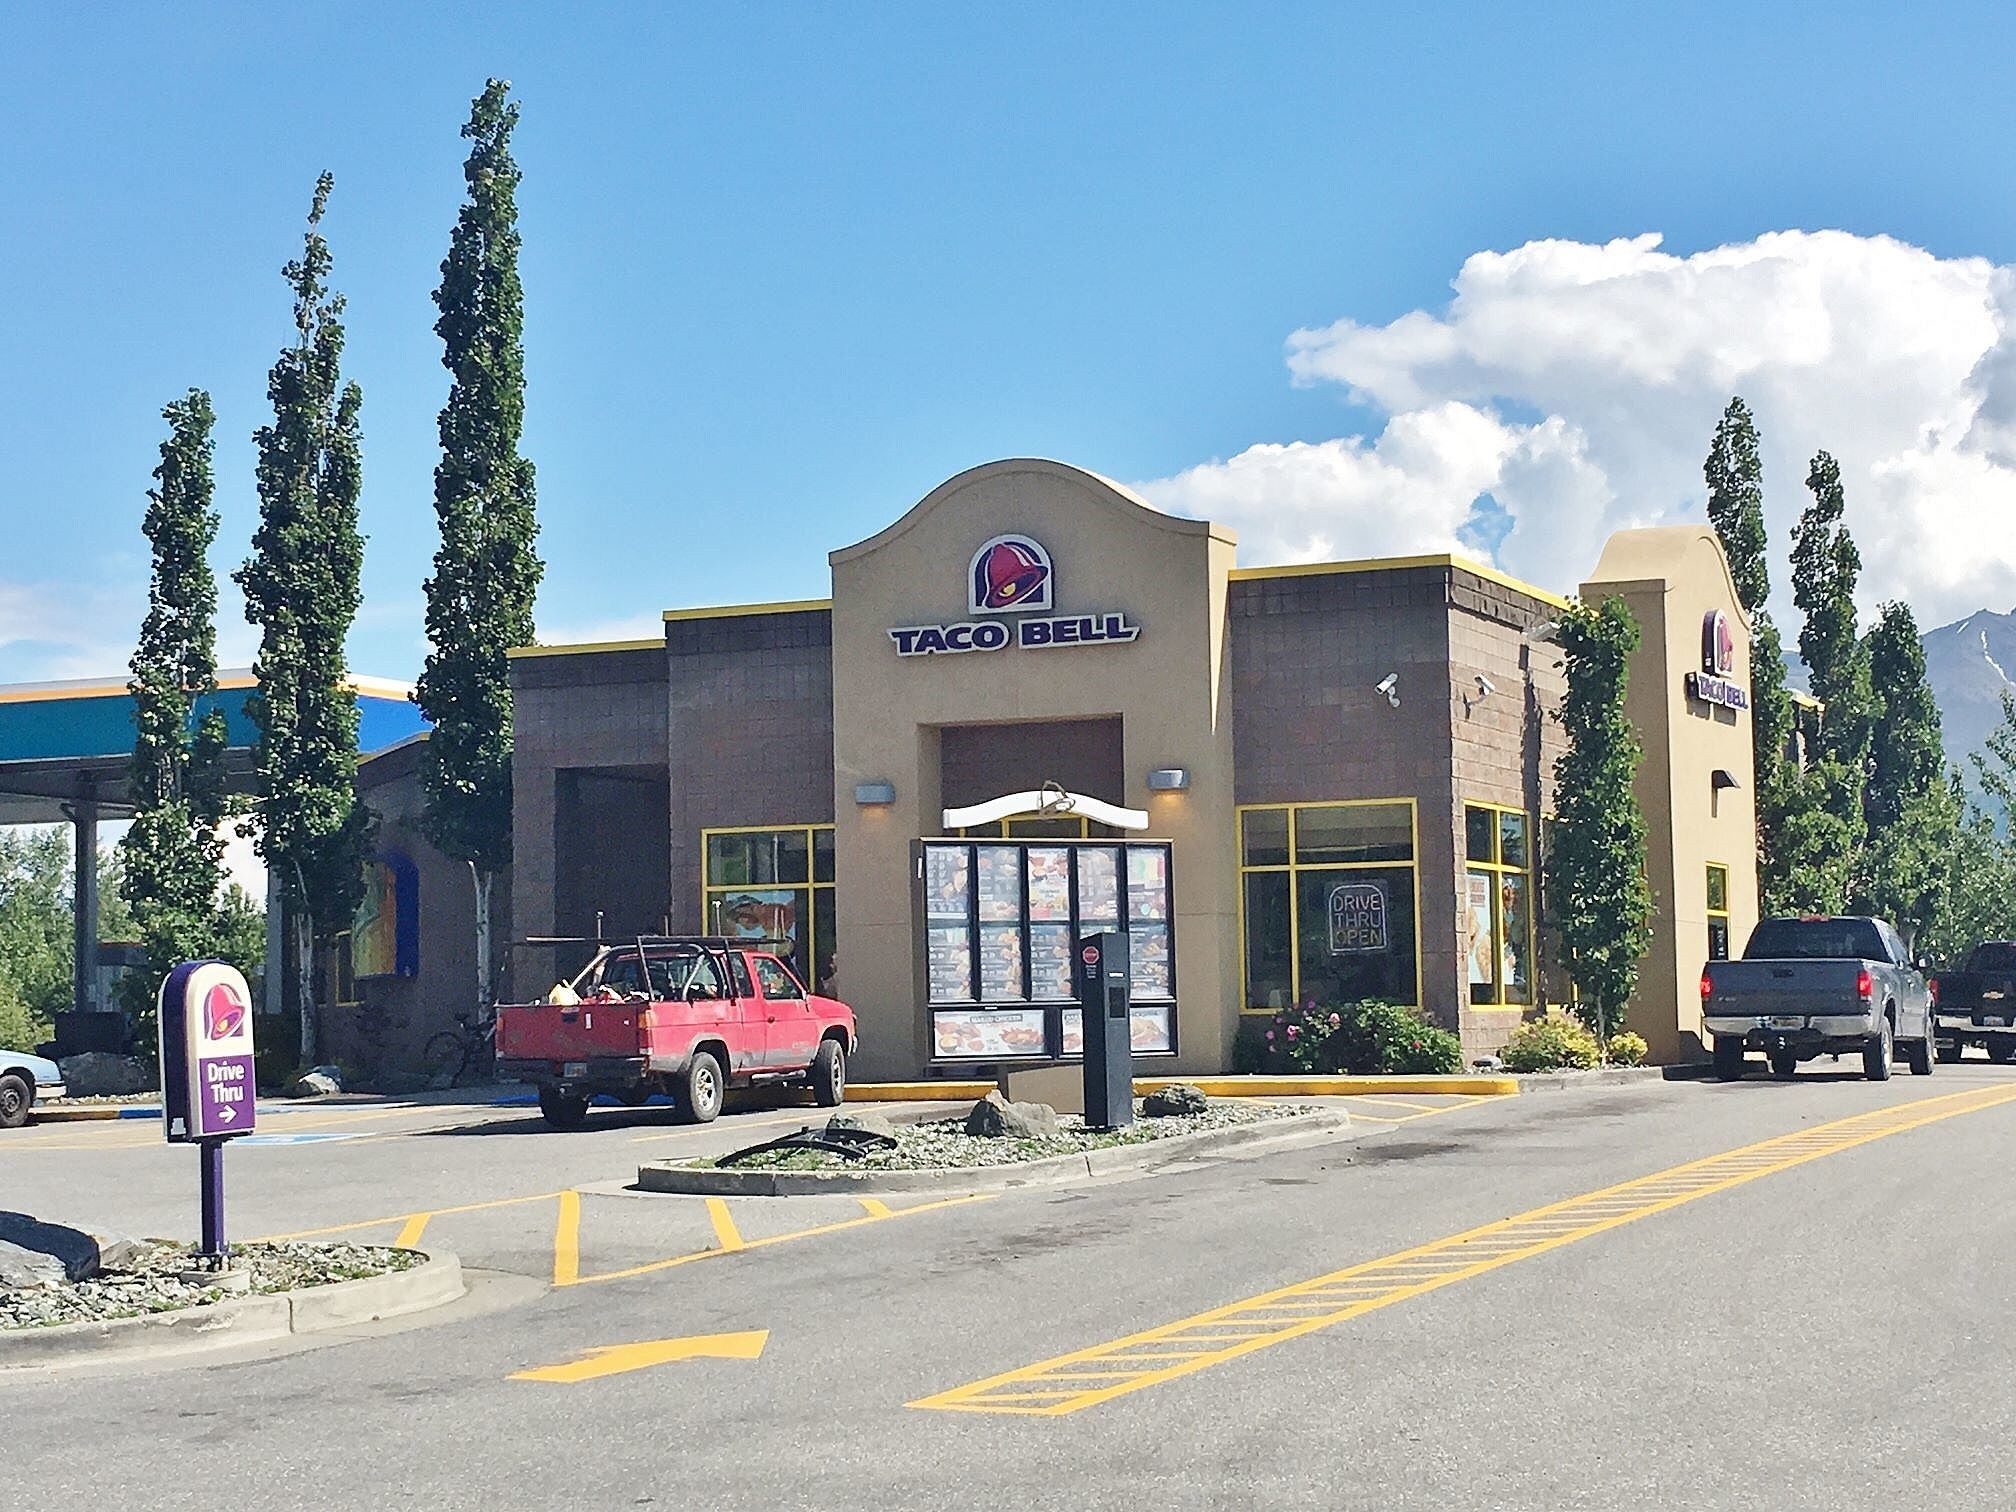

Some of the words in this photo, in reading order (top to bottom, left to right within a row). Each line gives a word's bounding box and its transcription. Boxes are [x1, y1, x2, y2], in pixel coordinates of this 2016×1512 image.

[891, 624, 1003, 653] TACO
[1021, 616, 1134, 646] BELL
[1698, 676, 1725, 701] TACO
[1333, 893, 1381, 912] DRIVE
[1334, 911, 1382, 928] THRU
[1335, 928, 1382, 945] OPEN
[207, 1061, 245, 1082] Drive
[211, 1083, 244, 1104] Thru
